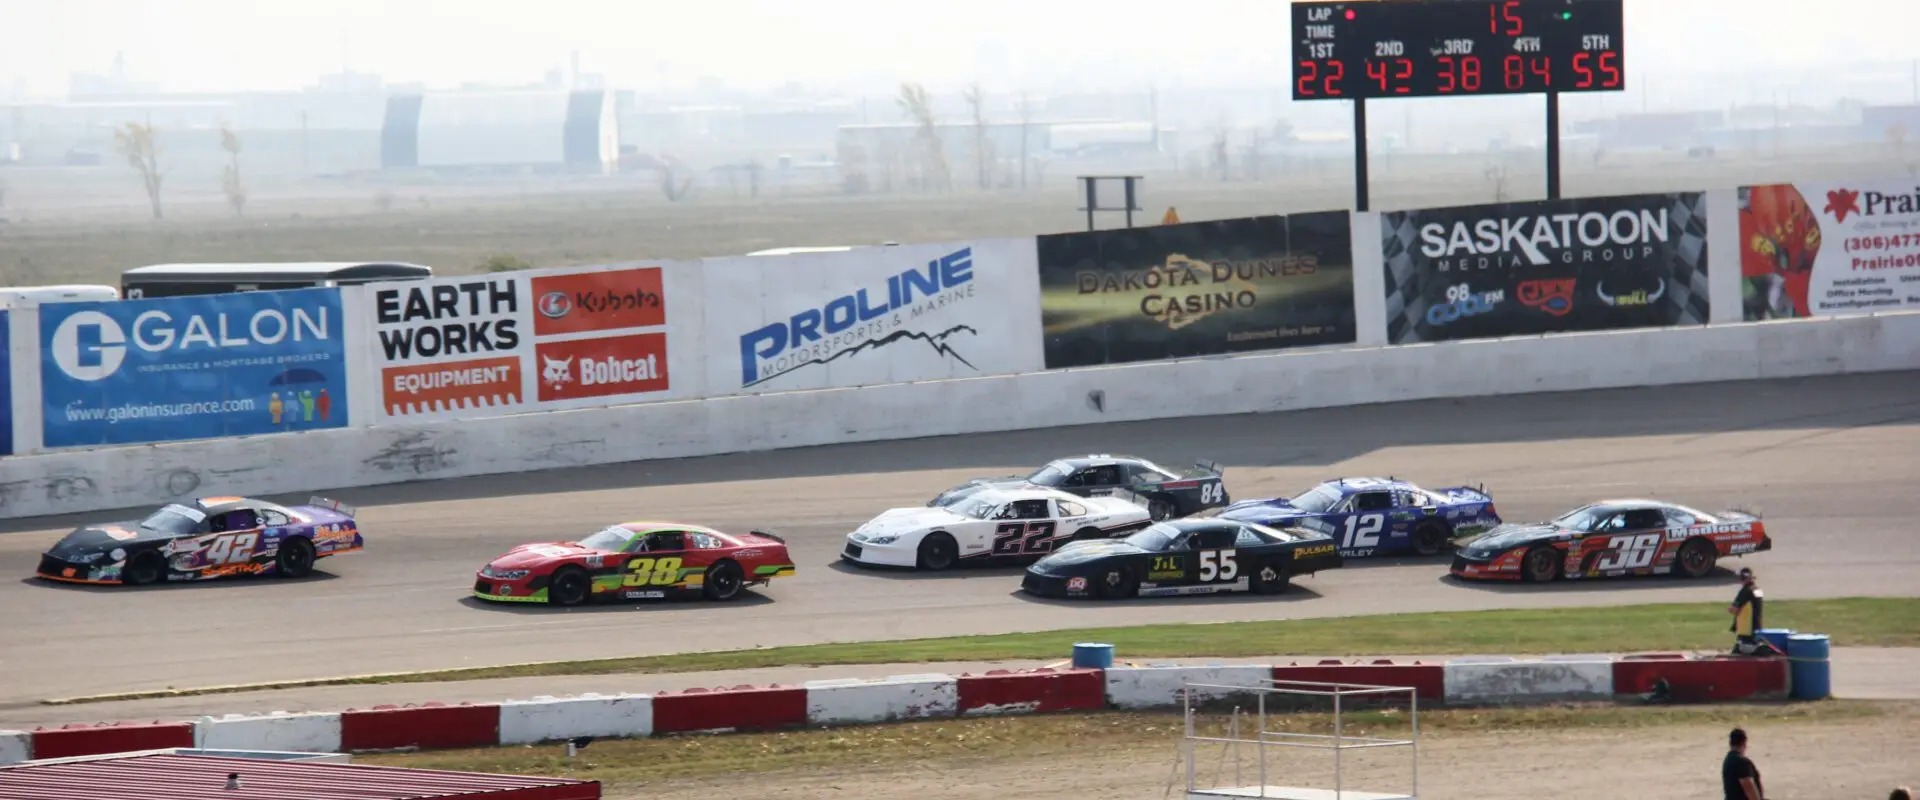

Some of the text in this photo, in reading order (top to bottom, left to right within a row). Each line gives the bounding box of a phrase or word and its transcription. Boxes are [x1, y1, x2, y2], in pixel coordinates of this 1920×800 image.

[1308, 8, 1332, 21] LAP
[1489, 1, 1523, 36] 15
[1306, 25, 1335, 39] TIME
[1309, 35, 1609, 58] 1ST 2ND 3RD 4TH 5TH
[1298, 52, 1619, 95] 22 42 38 84 55
[1420, 208, 1668, 265] SASKATOON
[1078, 256, 1318, 295] DAKOTA DUNES
[1438, 248, 1653, 272] MEDIA GROUP
[376, 279, 517, 324] EARTH
[576, 288, 659, 313] Kubota
[1140, 290, 1257, 317] CASINO
[1446, 283, 1469, 303] 98
[1484, 289, 1505, 304] FM
[132, 306, 329, 352] GALON
[740, 247, 974, 385] PROLINE
[761, 284, 976, 377] MOTORSPORTS & MARINE
[378, 319, 519, 360] WORKS
[137, 362, 199, 373] INSURANCE
[214, 356, 274, 368] MORTGAGE
[277, 353, 330, 364] BROKERS
[580, 354, 658, 386] Bobcat
[393, 366, 511, 393] EQUIPMENT
[66, 396, 254, 424] www.galoninsurance.com
[1200, 482, 1224, 505] 84
[992, 519, 1057, 556] 22
[1342, 513, 1385, 548] 12
[206, 532, 259, 565] 42
[1293, 544, 1335, 561] PULSAR
[1598, 533, 1660, 571] 36
[622, 557, 682, 587] 38
[1199, 549, 1238, 582] 55
